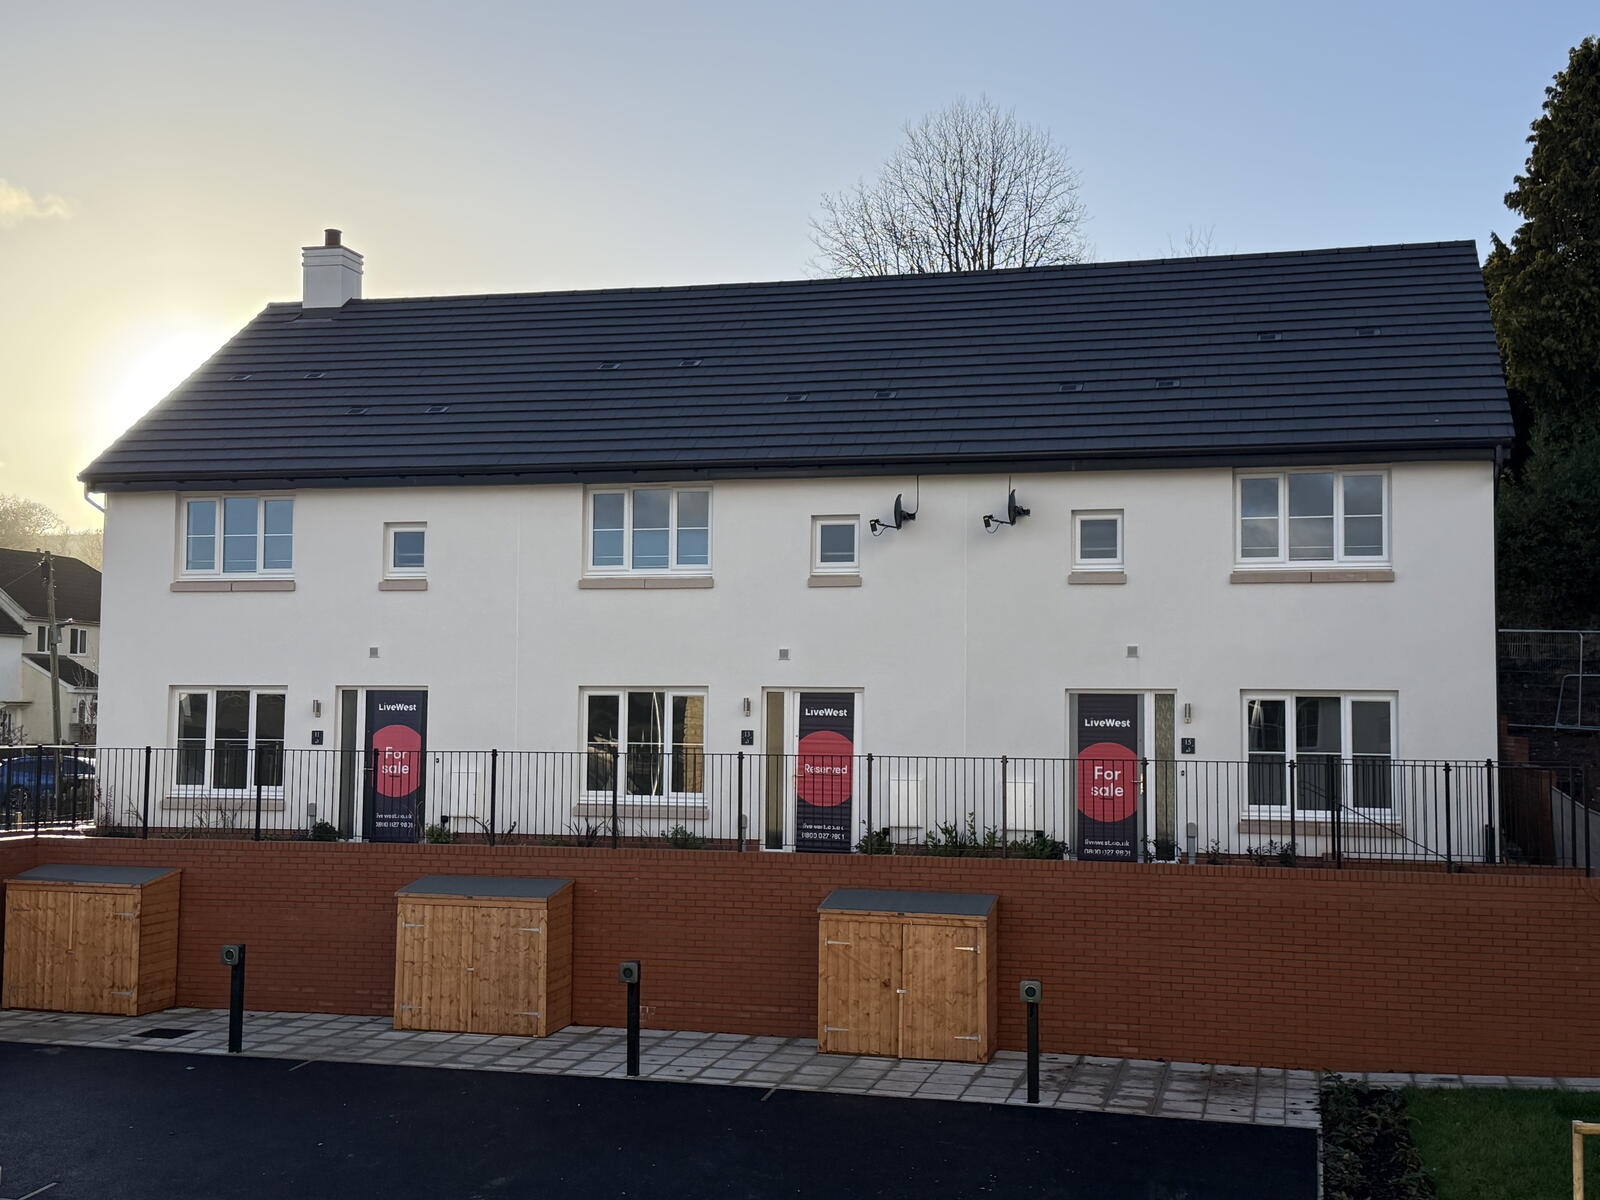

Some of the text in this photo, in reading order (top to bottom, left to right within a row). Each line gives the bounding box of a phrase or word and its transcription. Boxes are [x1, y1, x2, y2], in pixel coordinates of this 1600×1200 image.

[379, 703, 416, 711] LiveWest
[805, 707, 847, 717] LiveWest
[1084, 718, 1131, 728] LiveWest
[386, 746, 407, 759] For
[382, 762, 409, 774] sale
[805, 763, 848, 774] Reserved
[1094, 766, 1122, 780] For
[1091, 783, 1124, 797] sale
